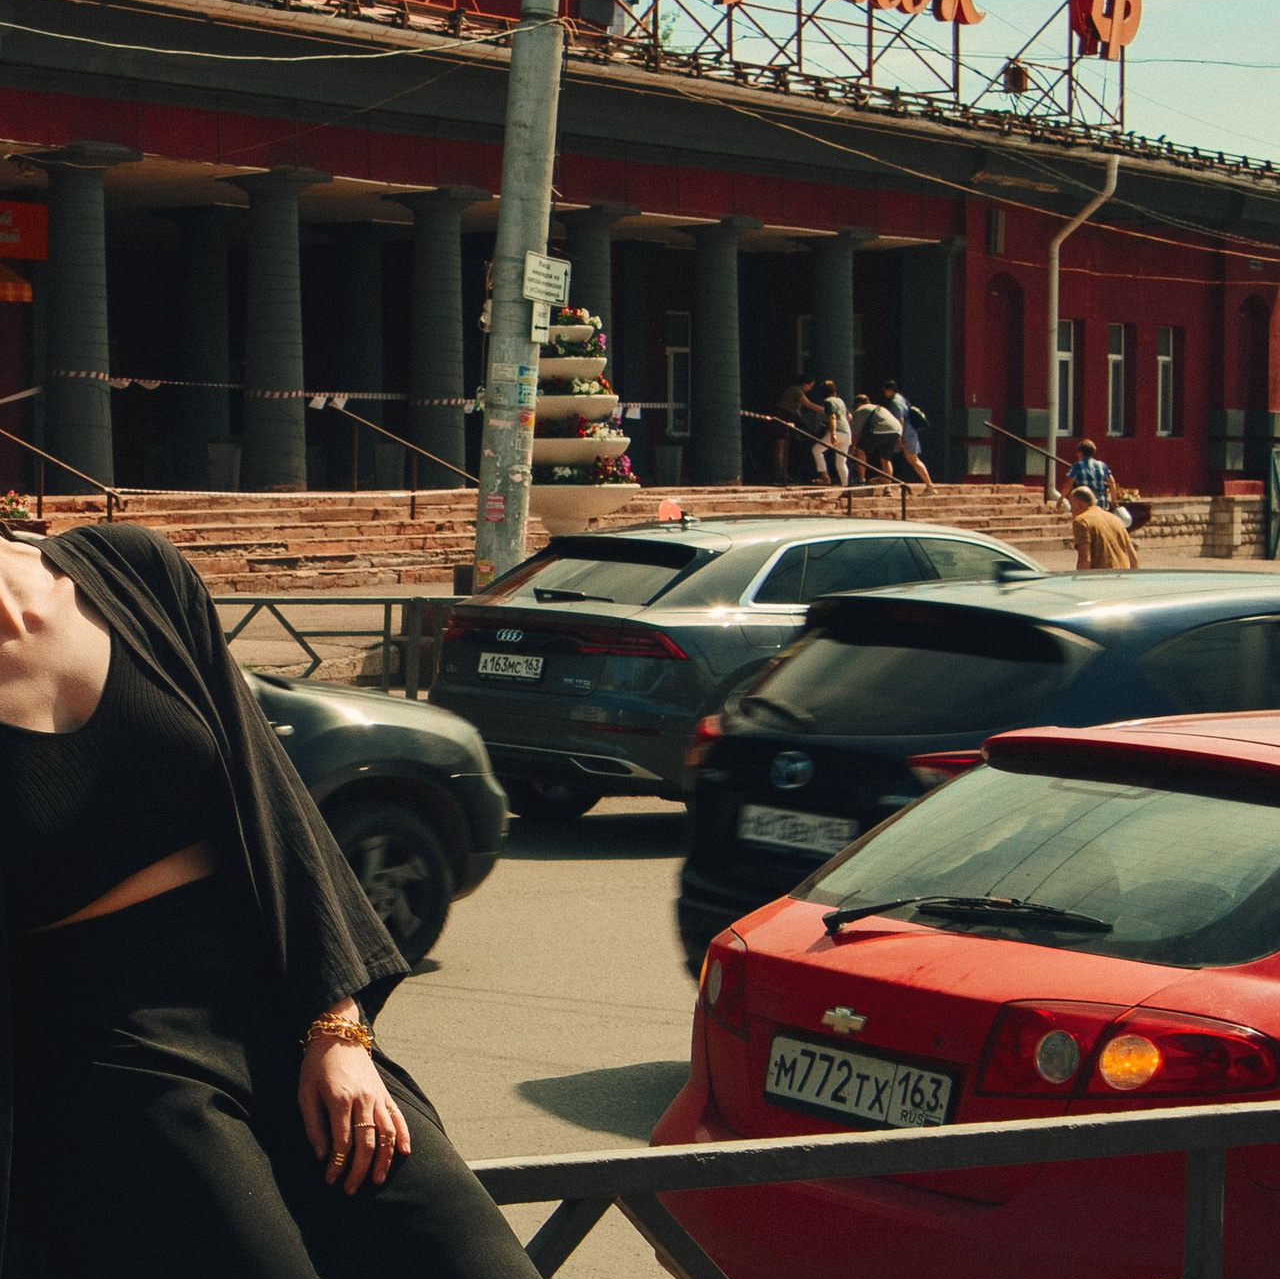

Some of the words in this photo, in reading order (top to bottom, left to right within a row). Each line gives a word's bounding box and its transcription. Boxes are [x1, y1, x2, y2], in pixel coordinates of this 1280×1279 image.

[481, 656, 521, 674] А163МС
[524, 658, 540, 671] 163
[774, 1048, 890, 1114] М772ТХ
[897, 1071, 943, 1113] 163
[899, 1109, 925, 1126] RUS
